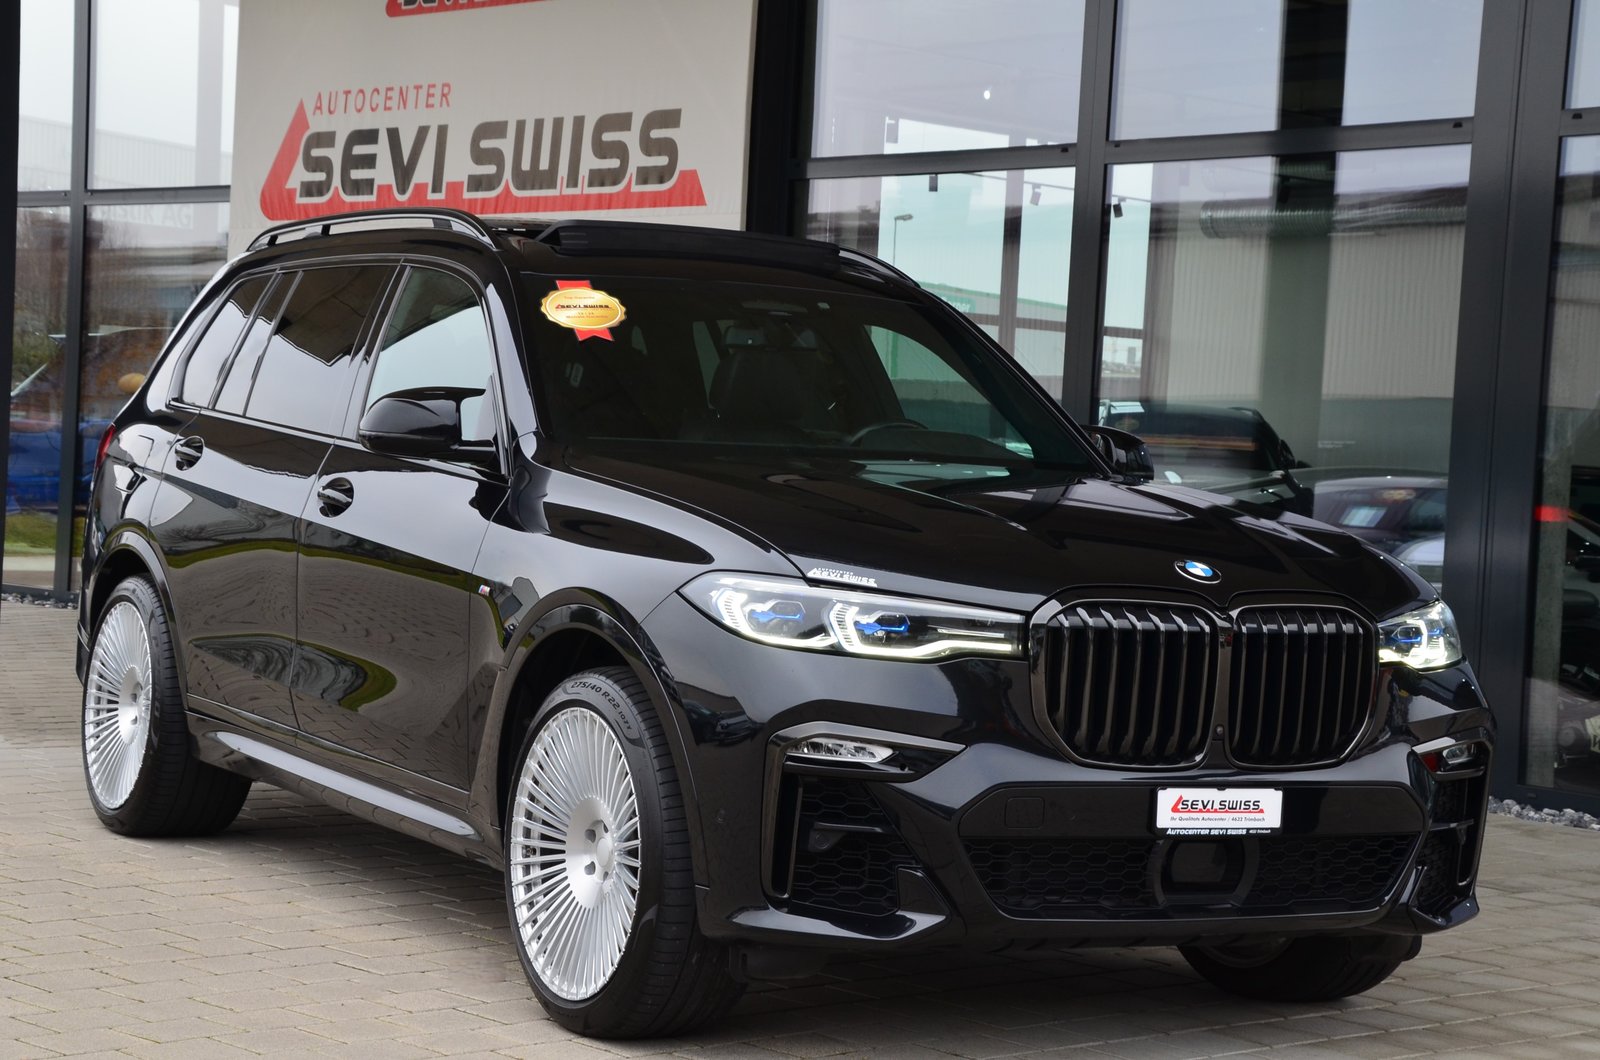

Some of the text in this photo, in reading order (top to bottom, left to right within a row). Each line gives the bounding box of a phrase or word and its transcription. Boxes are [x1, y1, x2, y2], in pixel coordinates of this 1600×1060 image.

[312, 82, 451, 116] AUTOCENTER
[299, 108, 682, 198] SEVI SWISS
[571, 681, 602, 693] 275/40
[601, 691, 621, 710] R22
[1180, 799, 1261, 811] SEVI SWISS
